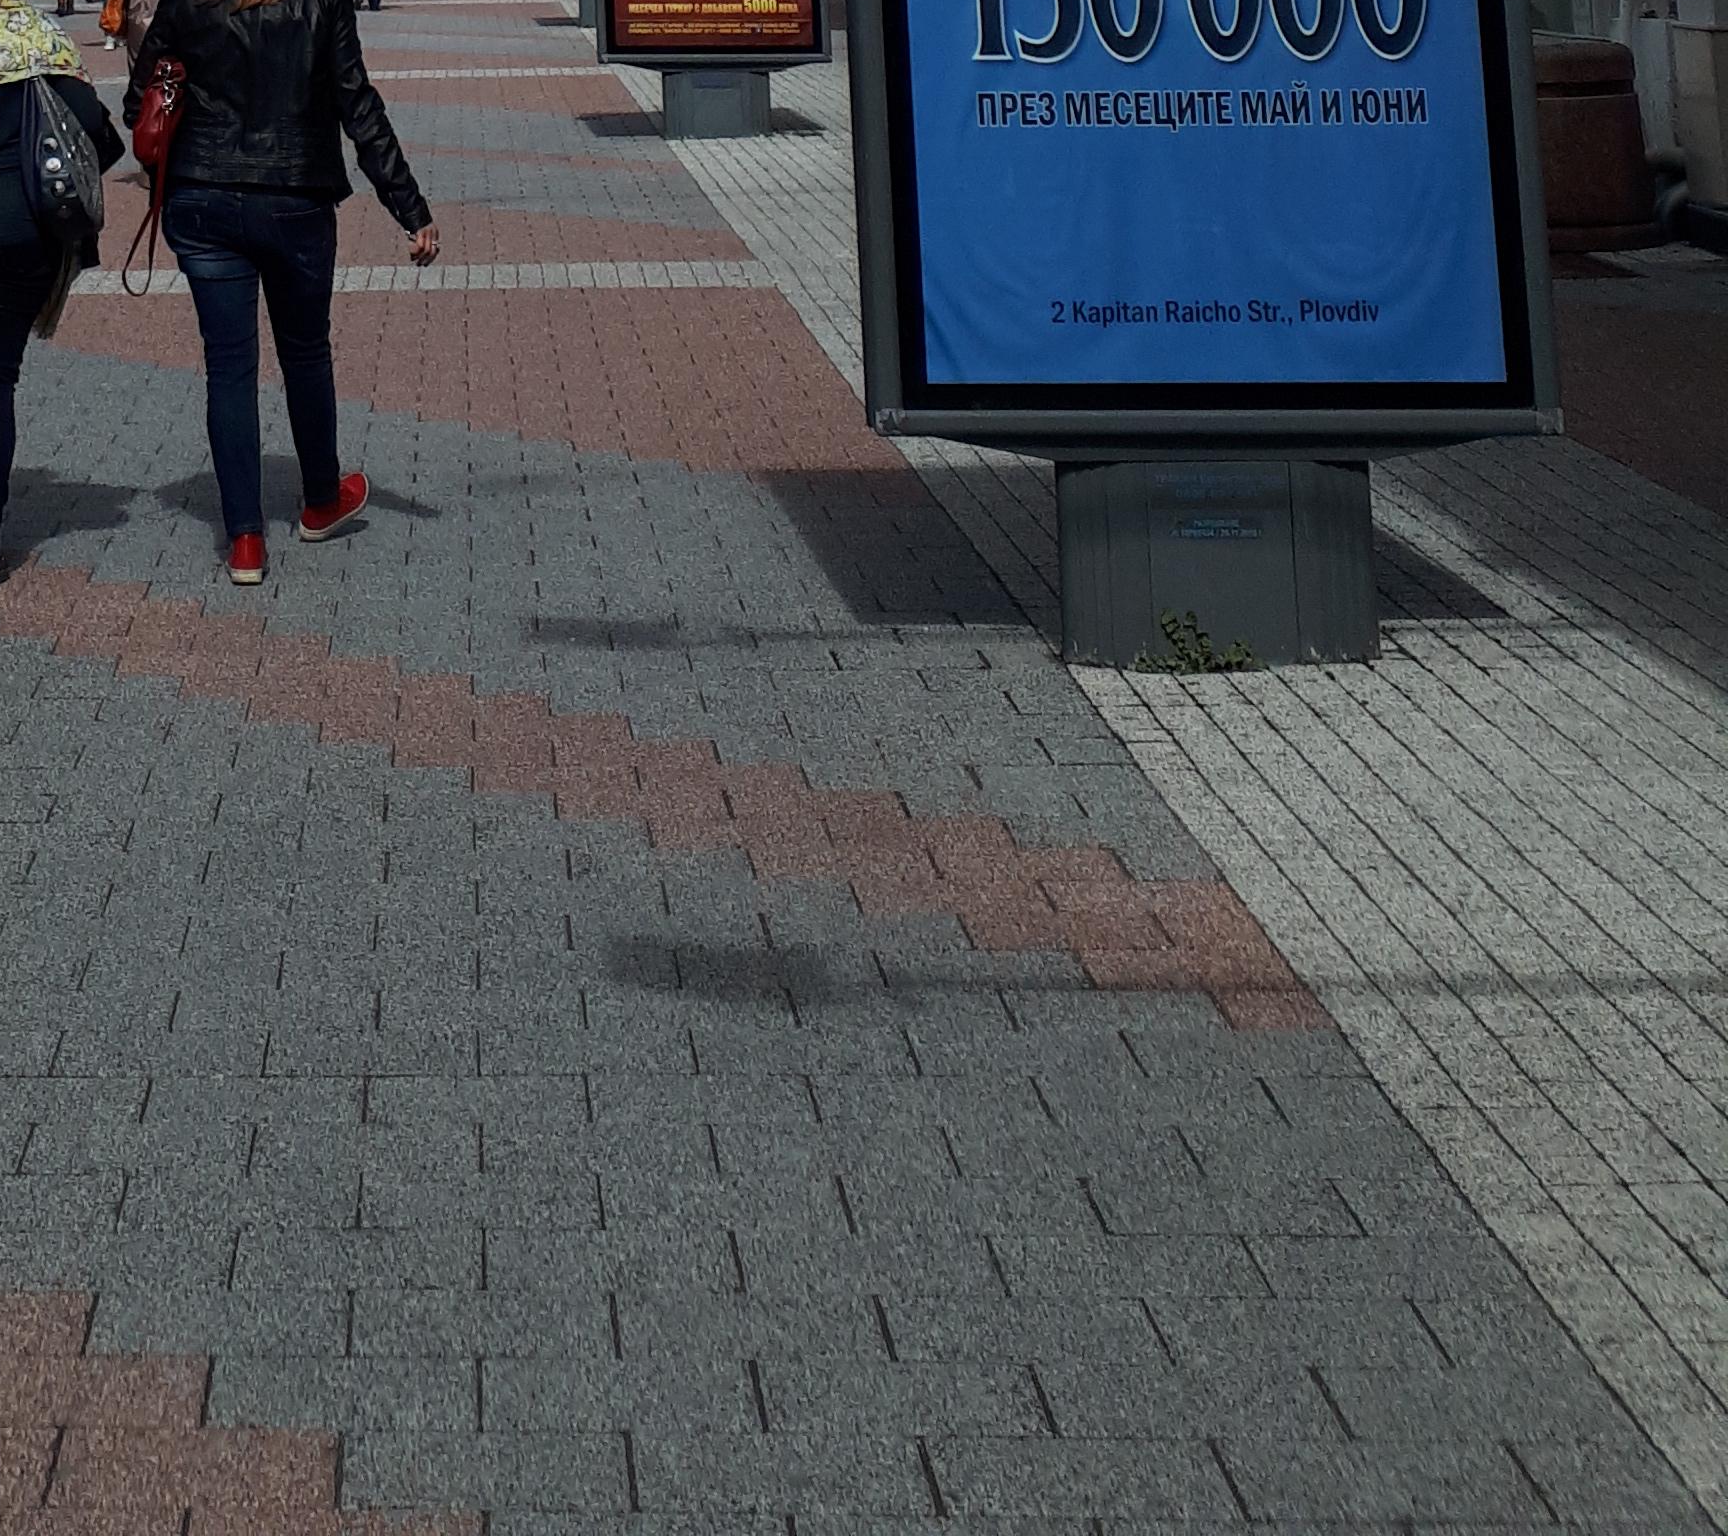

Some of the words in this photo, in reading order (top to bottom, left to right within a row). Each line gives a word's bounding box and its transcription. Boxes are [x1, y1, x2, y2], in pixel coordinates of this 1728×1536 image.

[976, 90, 1057, 127] ПРЕЗ
[1064, 89, 1234, 133] МЕСЕЦИТЕ
[1241, 80, 1312, 126] МАЙ
[1319, 88, 1343, 125] И
[1352, 87, 1429, 125] ЮНИ
[1051, 302, 1065, 324] 2
[1072, 300, 1158, 328] Kapitan
[1165, 300, 1242, 323] Raicho
[1248, 299, 1294, 327] Str.,
[1299, 298, 1379, 323] Plovdiv
